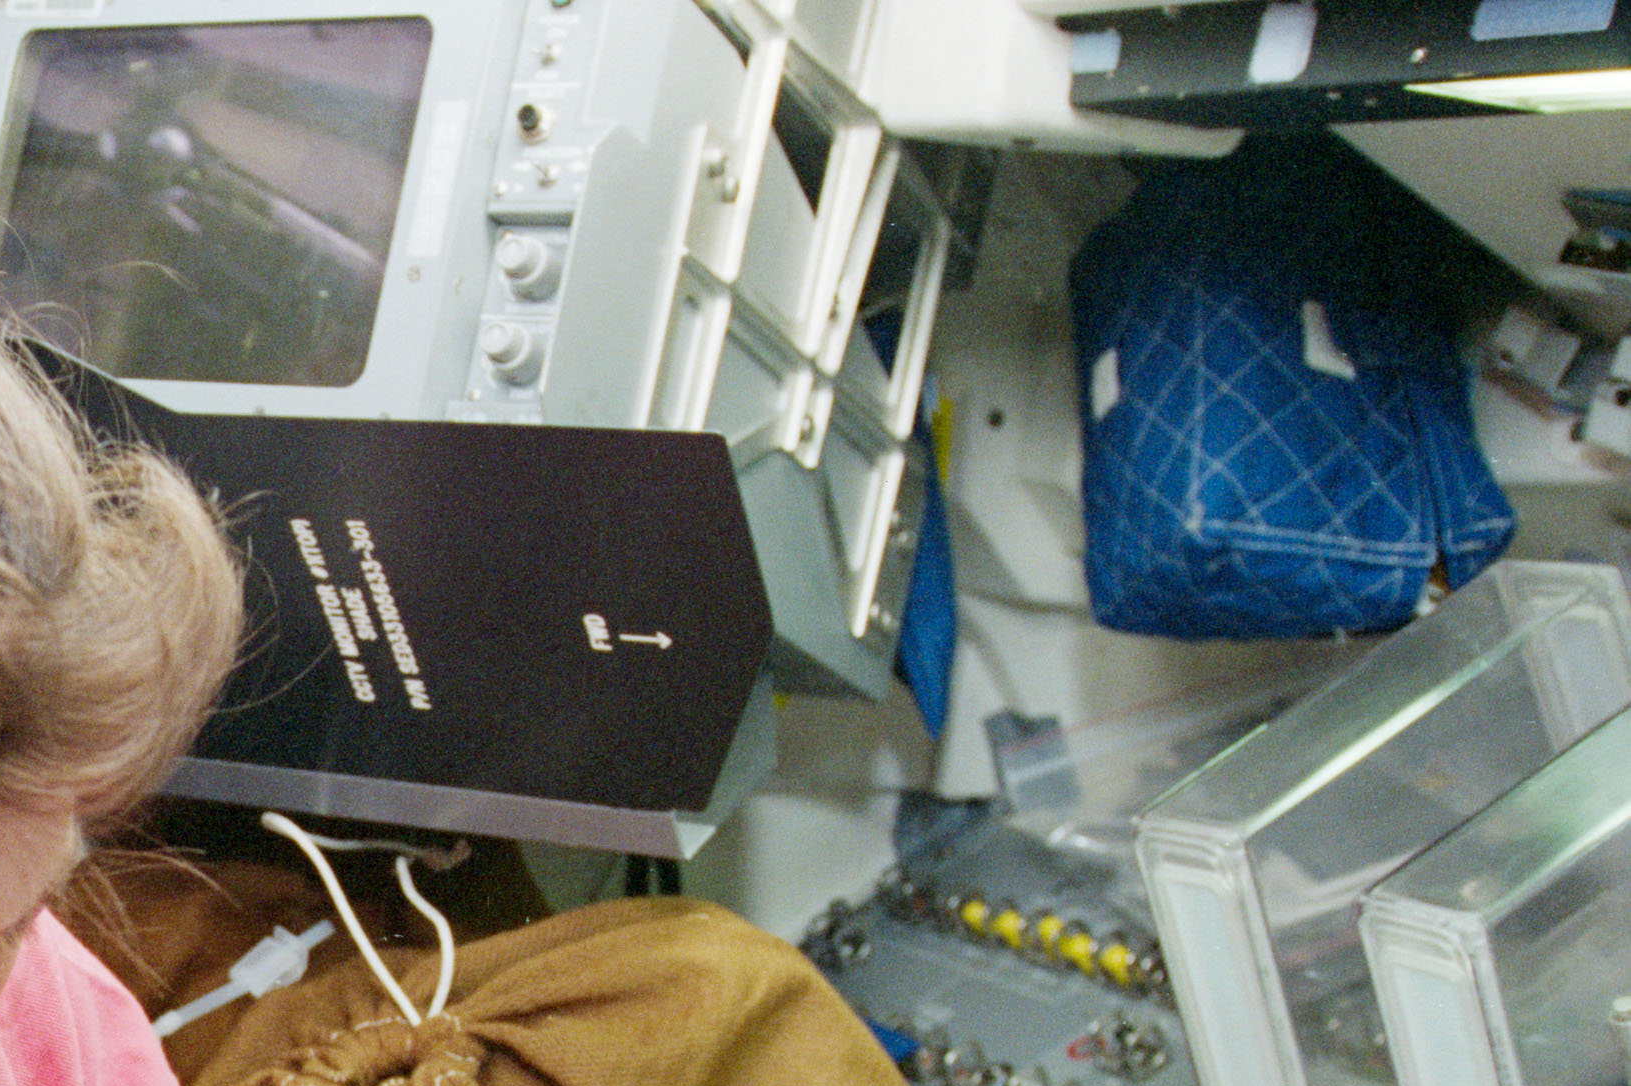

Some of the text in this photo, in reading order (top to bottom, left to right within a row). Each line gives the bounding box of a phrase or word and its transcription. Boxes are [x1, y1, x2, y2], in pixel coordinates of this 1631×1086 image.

[315, 584, 360, 658] MONITOR
[340, 586, 378, 641] SHADE
[582, 613, 613, 652] FWD
[344, 659, 376, 703] CCTV
[403, 678, 432, 711] P/N
